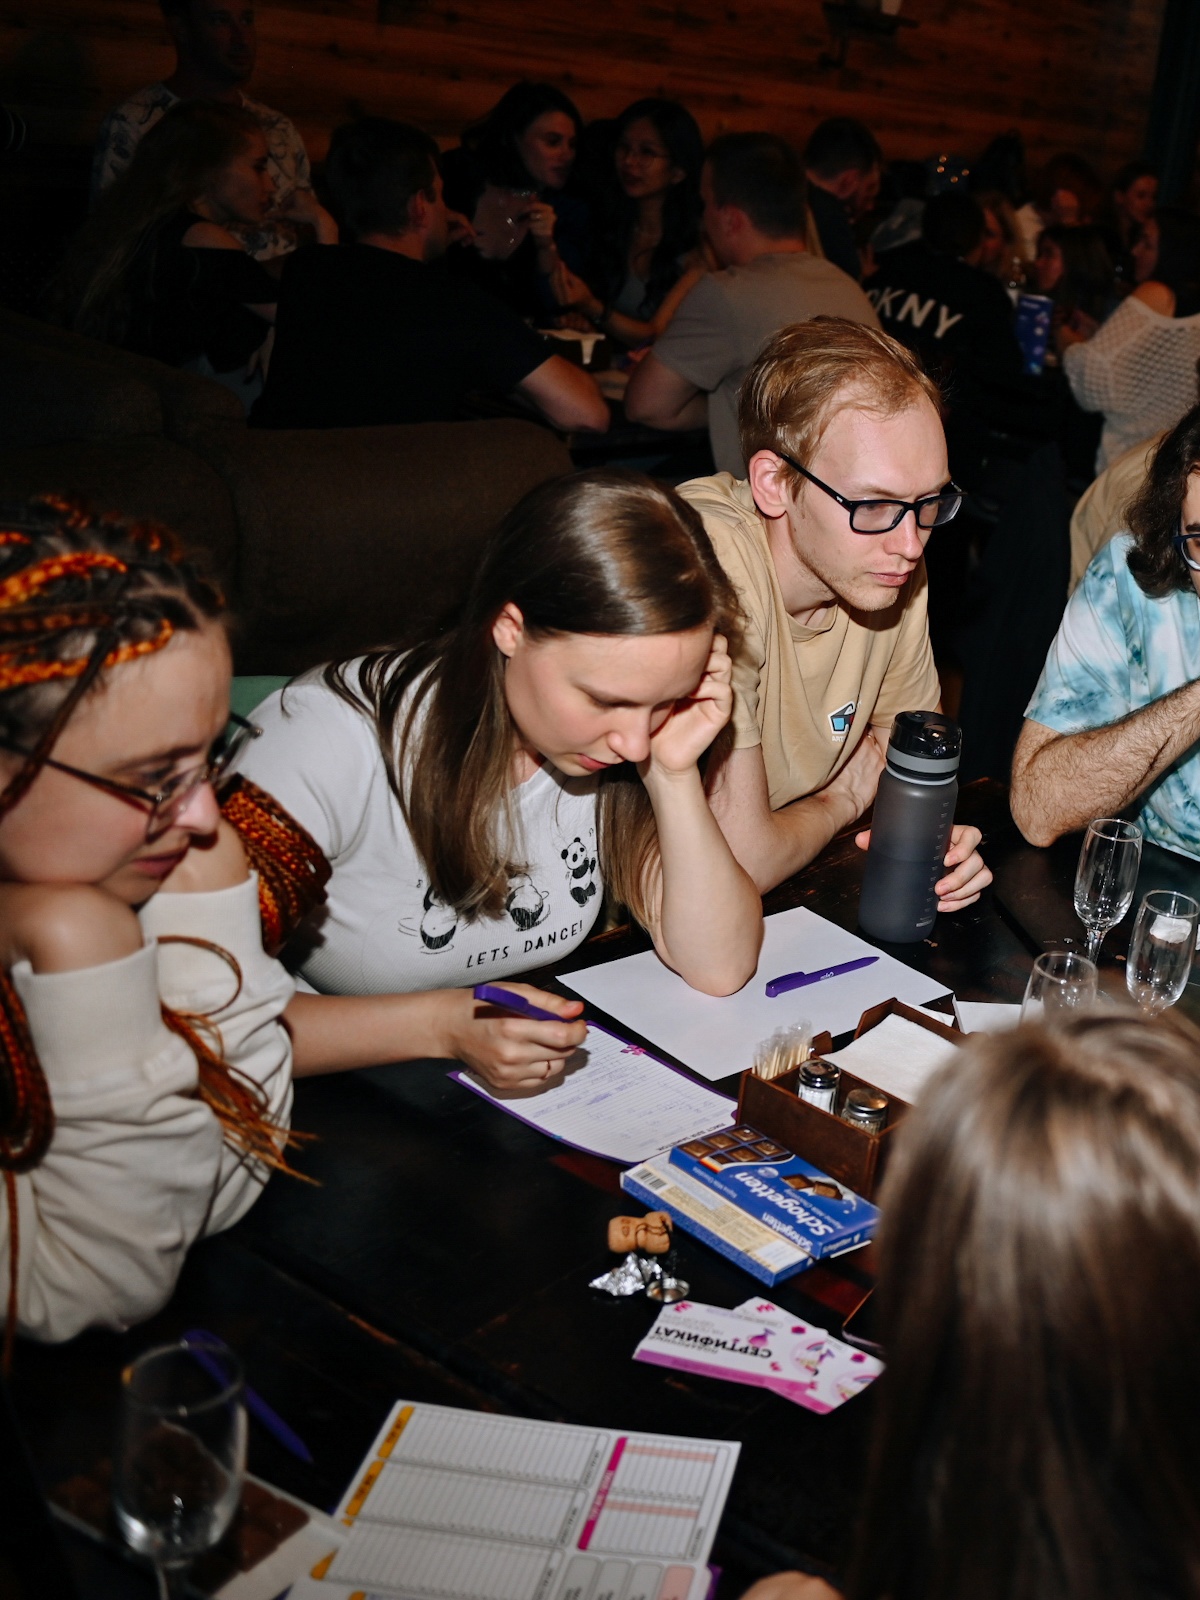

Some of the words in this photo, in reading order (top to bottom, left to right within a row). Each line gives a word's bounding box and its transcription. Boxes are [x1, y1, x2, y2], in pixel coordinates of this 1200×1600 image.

[466, 945, 510, 968] LETS
[523, 920, 583, 953] DANCE!
[734, 1172, 835, 1236] Schogetten
[761, 1212, 814, 1253] Schogetten
